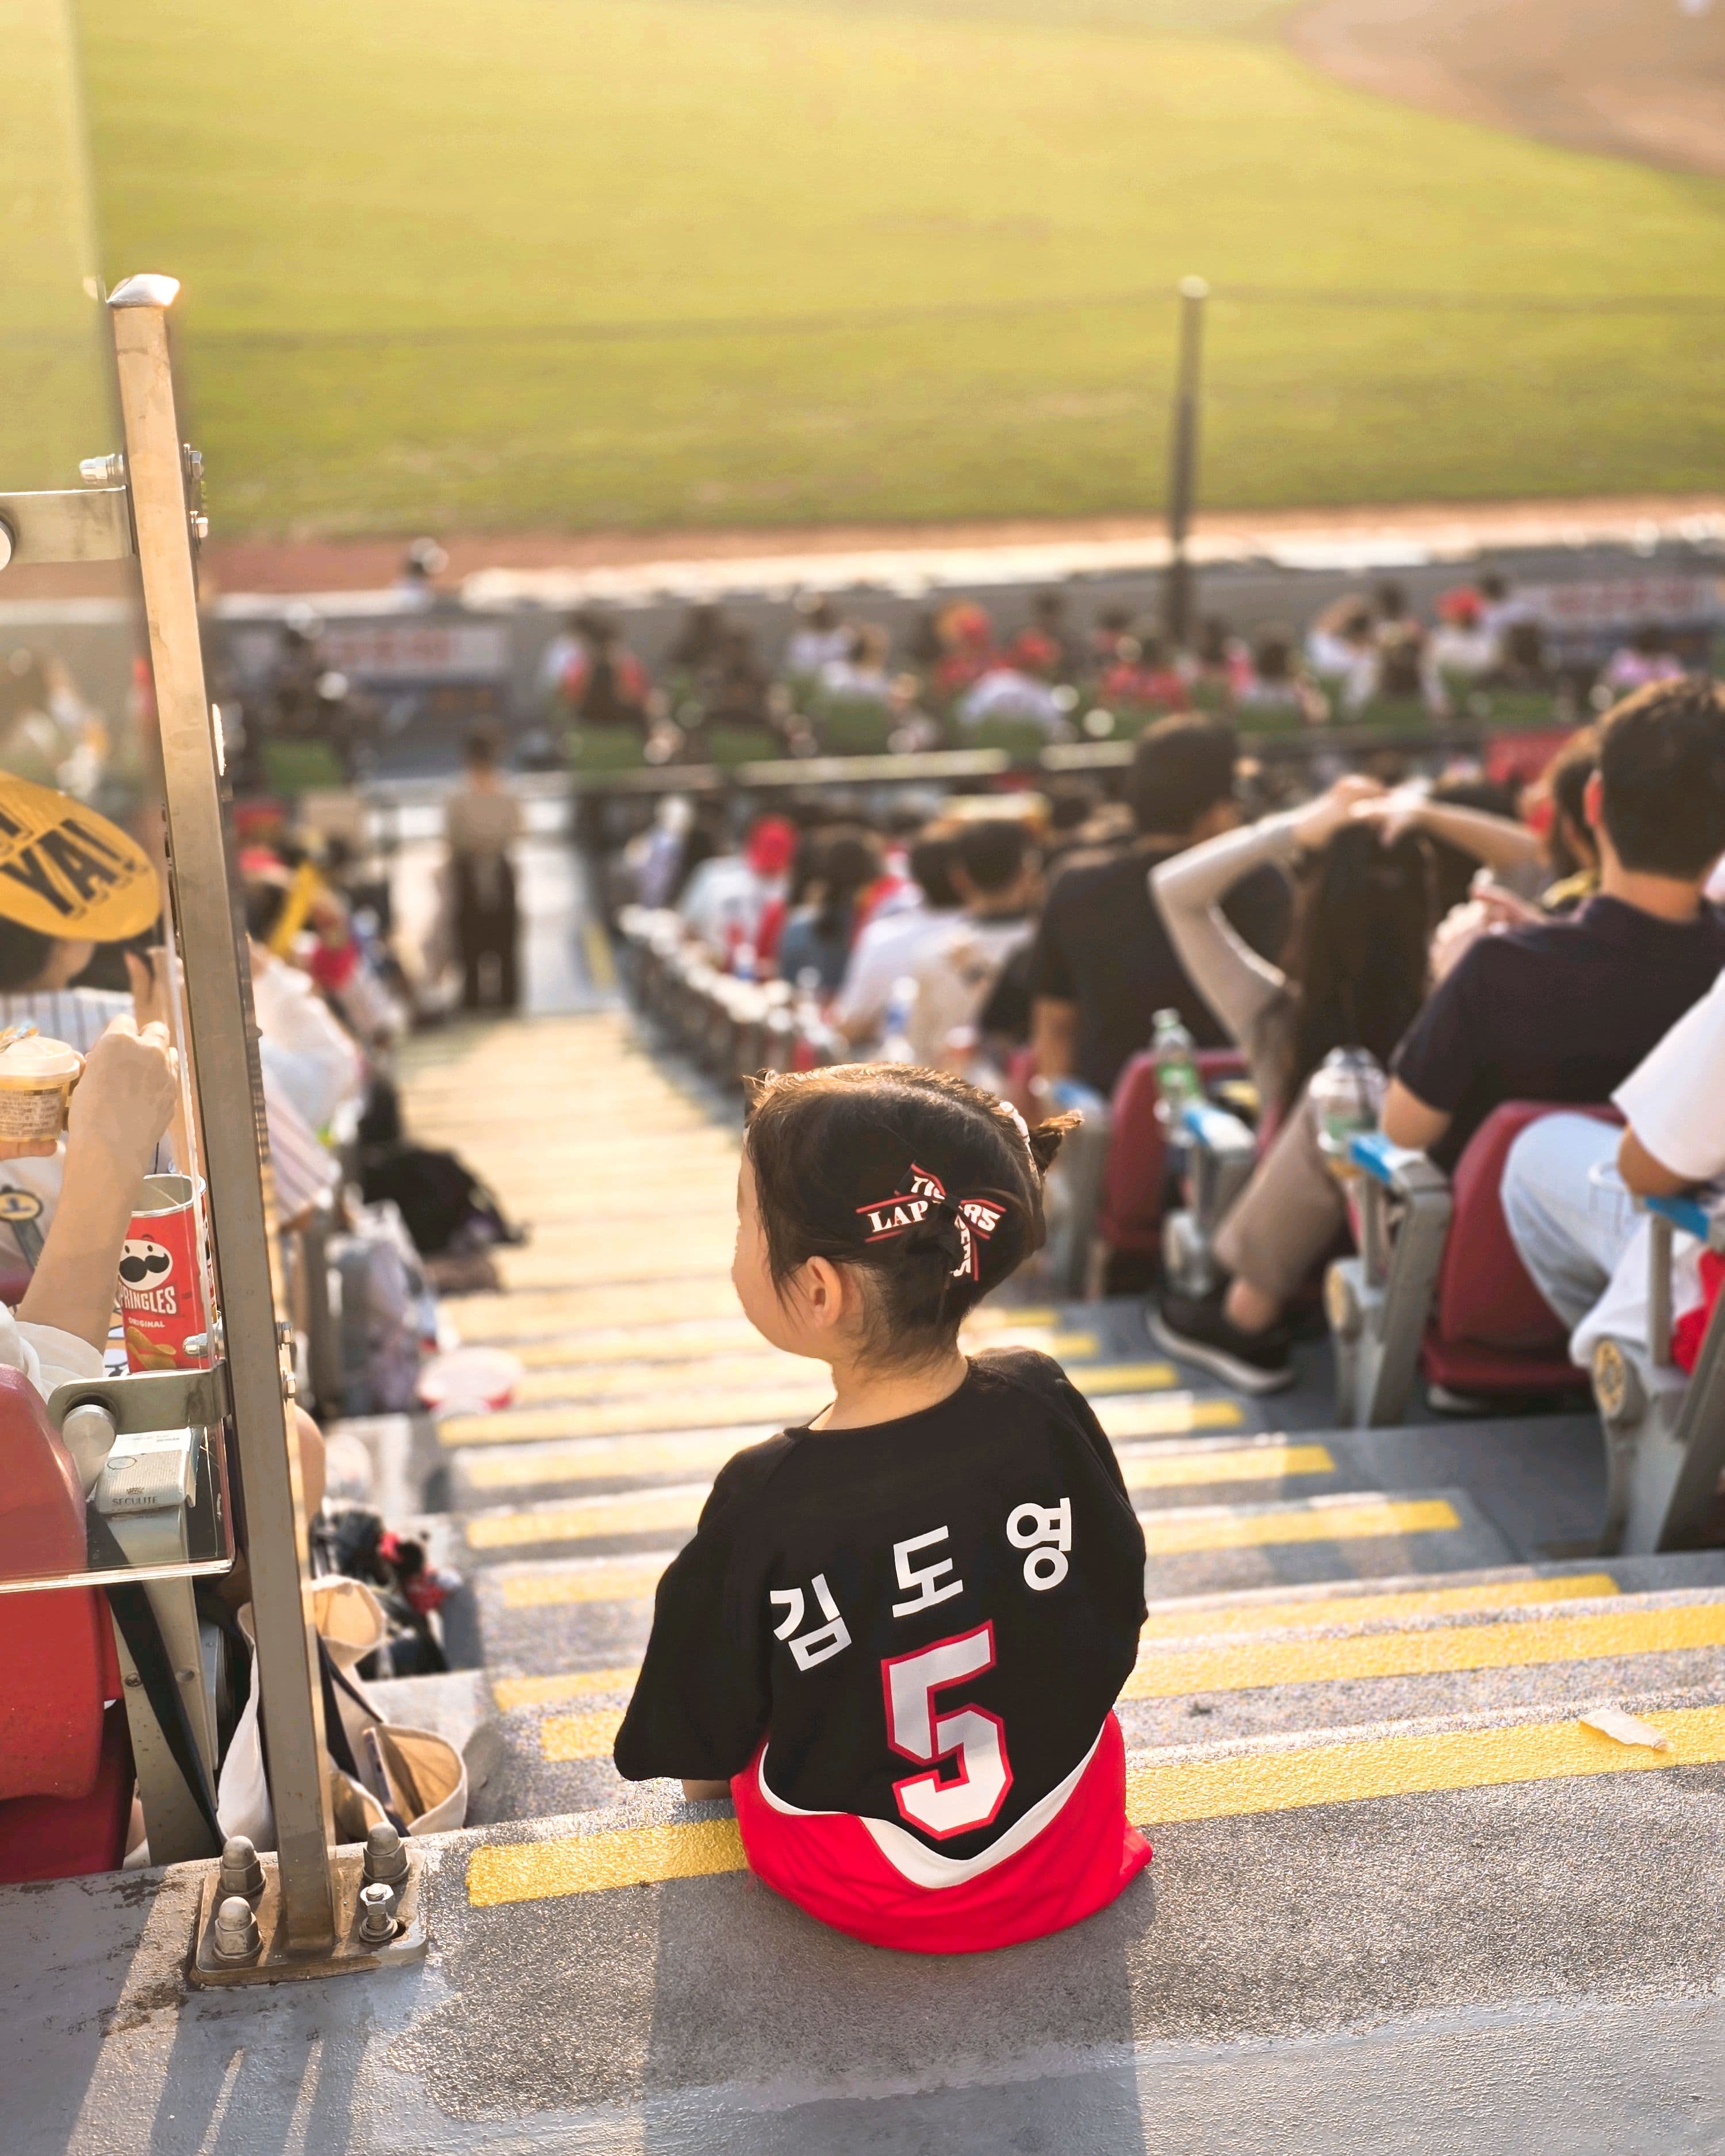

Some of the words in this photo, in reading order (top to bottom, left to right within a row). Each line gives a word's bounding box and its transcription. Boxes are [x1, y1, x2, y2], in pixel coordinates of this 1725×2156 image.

[0, 818, 136, 916] YA!
[867, 1200, 929, 1233] LAP
[958, 1204, 1001, 1232] RS
[118, 1282, 177, 1314] PRINGLES
[128, 1317, 166, 1328] ORIGINAL
[880, 1619, 1014, 1840] 5
